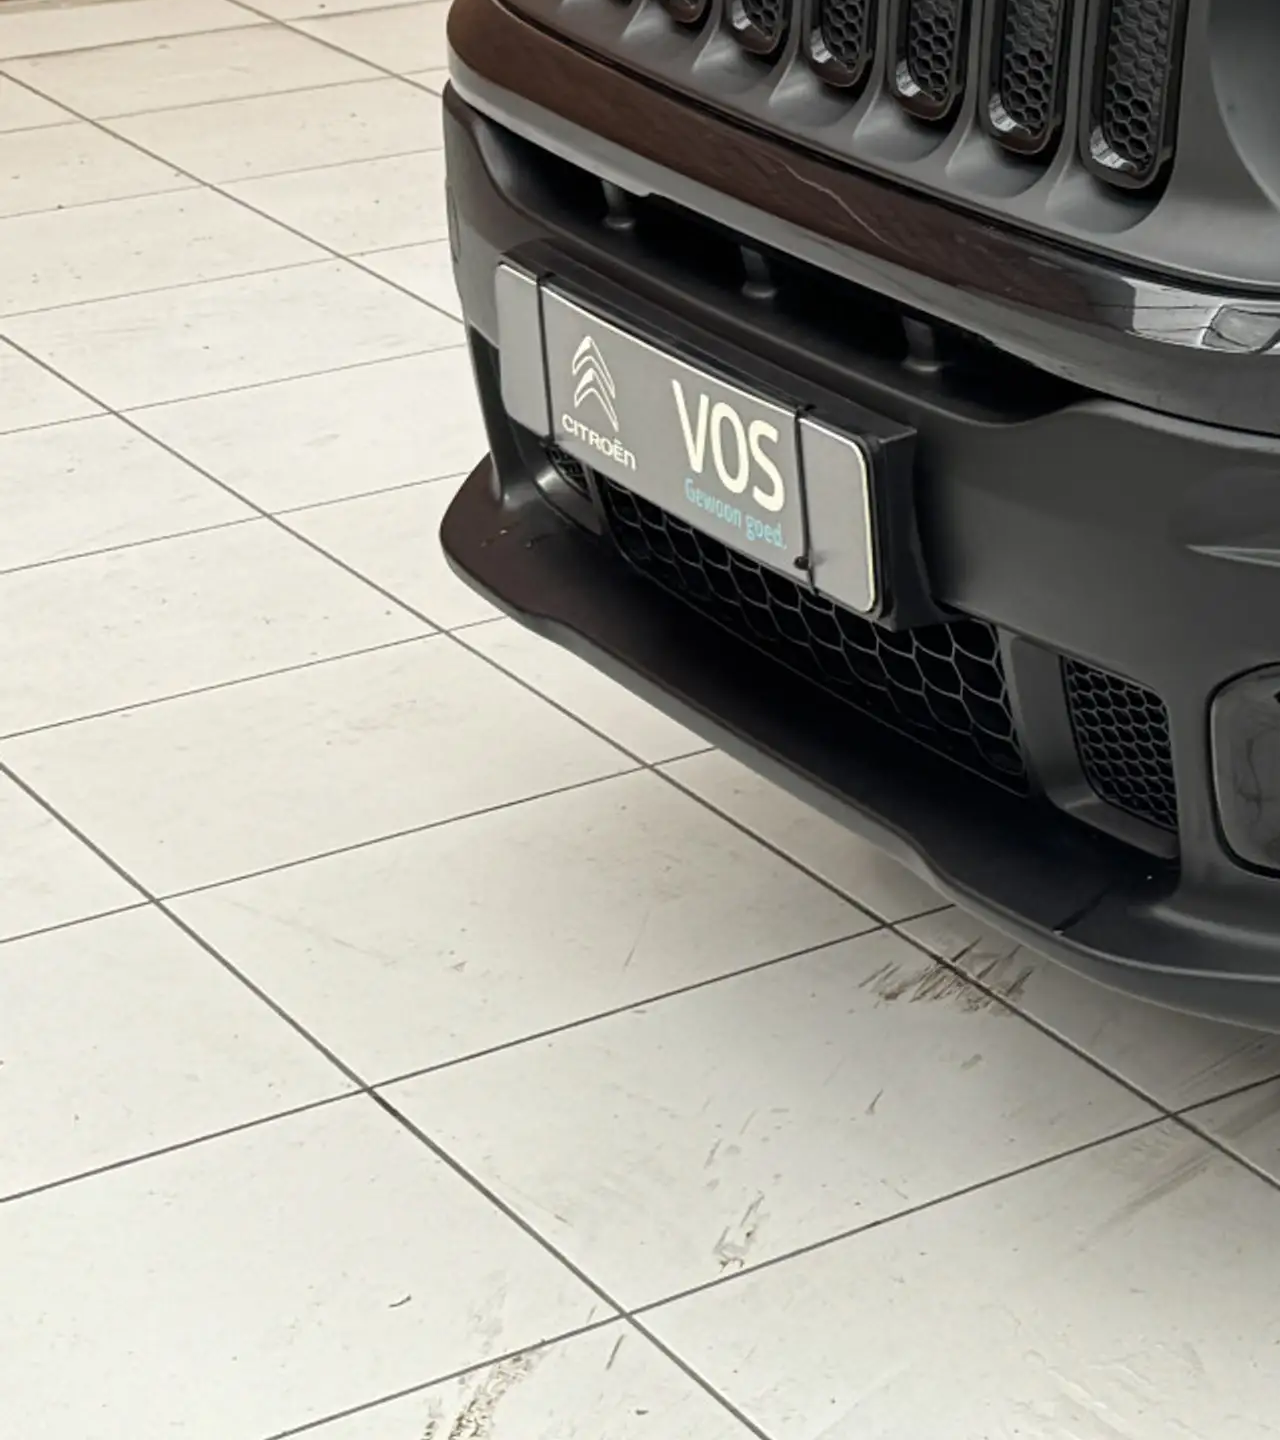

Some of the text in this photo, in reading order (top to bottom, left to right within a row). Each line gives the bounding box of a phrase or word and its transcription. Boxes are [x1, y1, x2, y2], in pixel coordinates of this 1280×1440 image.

[671, 378, 786, 513] VOS
[683, 477, 787, 550] Gewoon goed.
